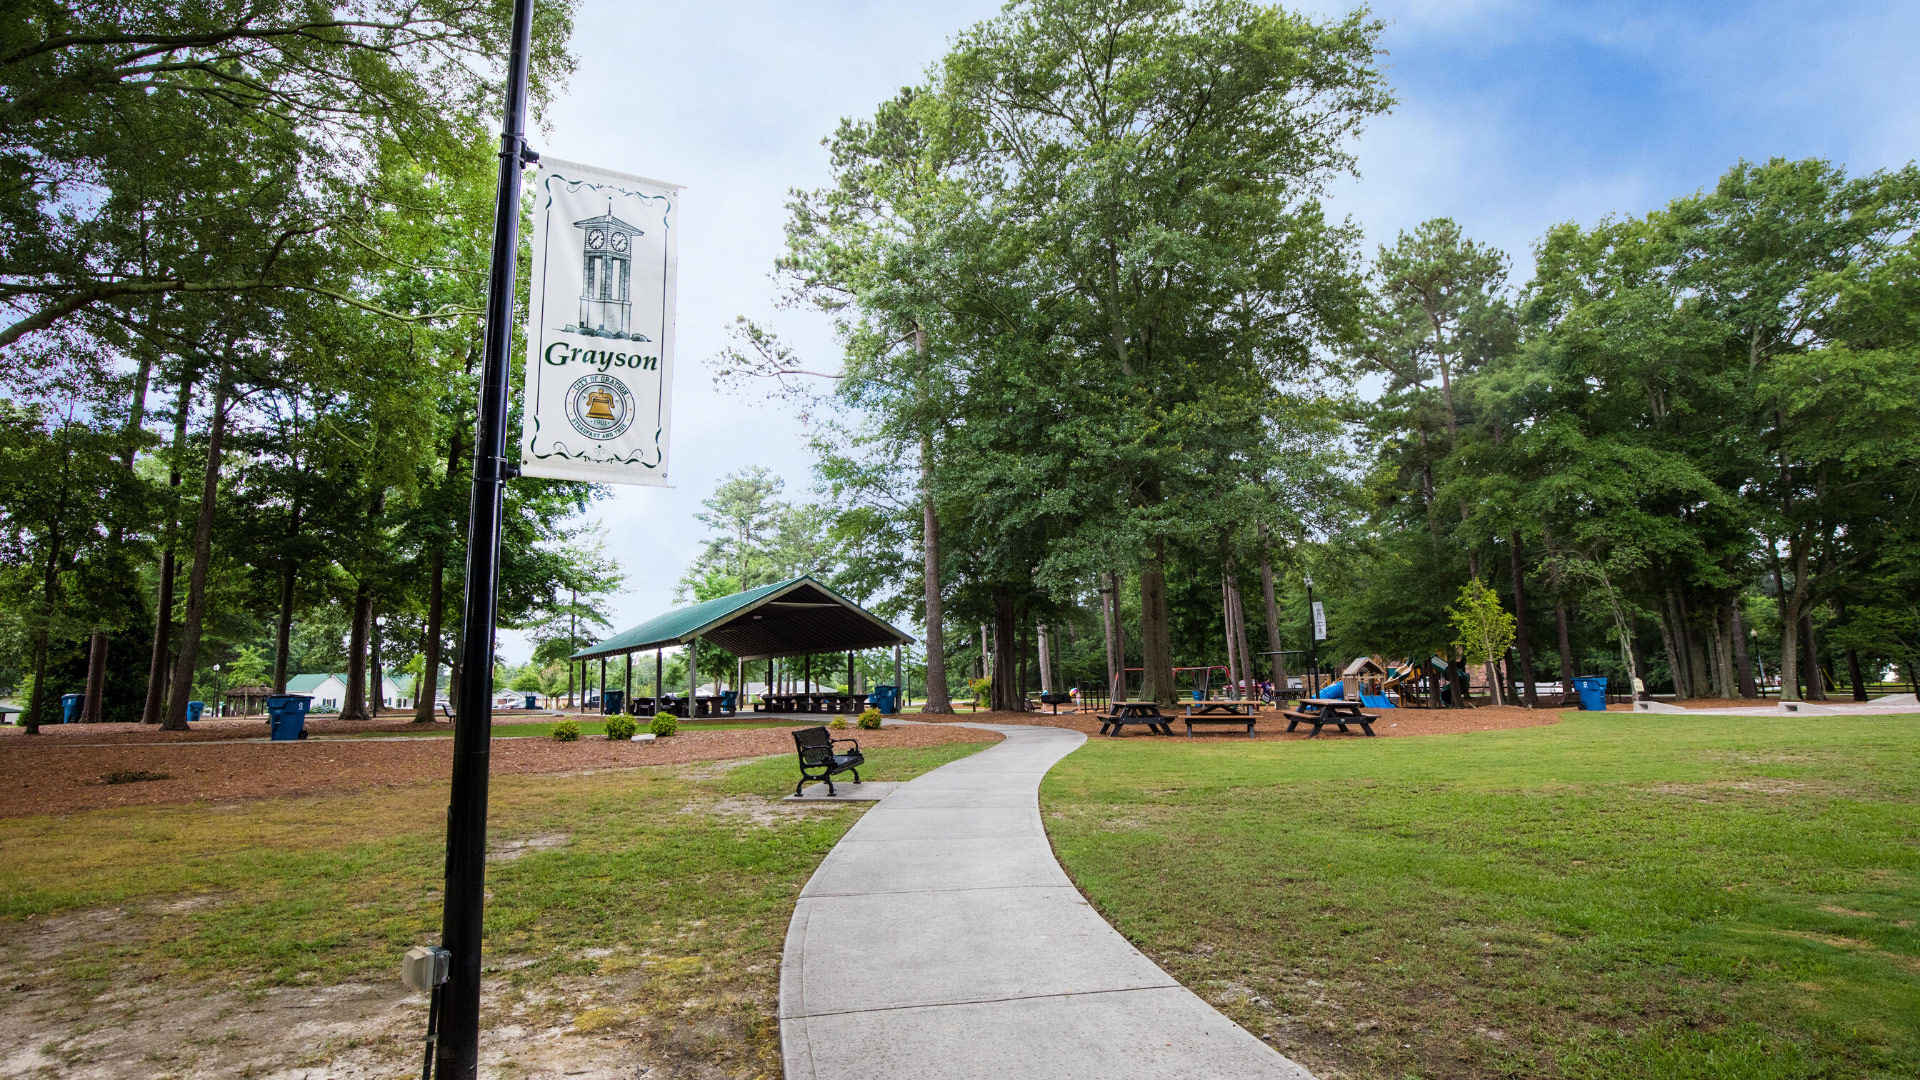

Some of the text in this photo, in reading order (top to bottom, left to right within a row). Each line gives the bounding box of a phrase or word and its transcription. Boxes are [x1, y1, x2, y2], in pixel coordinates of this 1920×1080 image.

[545, 342, 658, 372] Grayson
[573, 378, 588, 391] CITY
[600, 375, 629, 396] GRAYSON
[571, 418, 600, 438] STEADFAST
